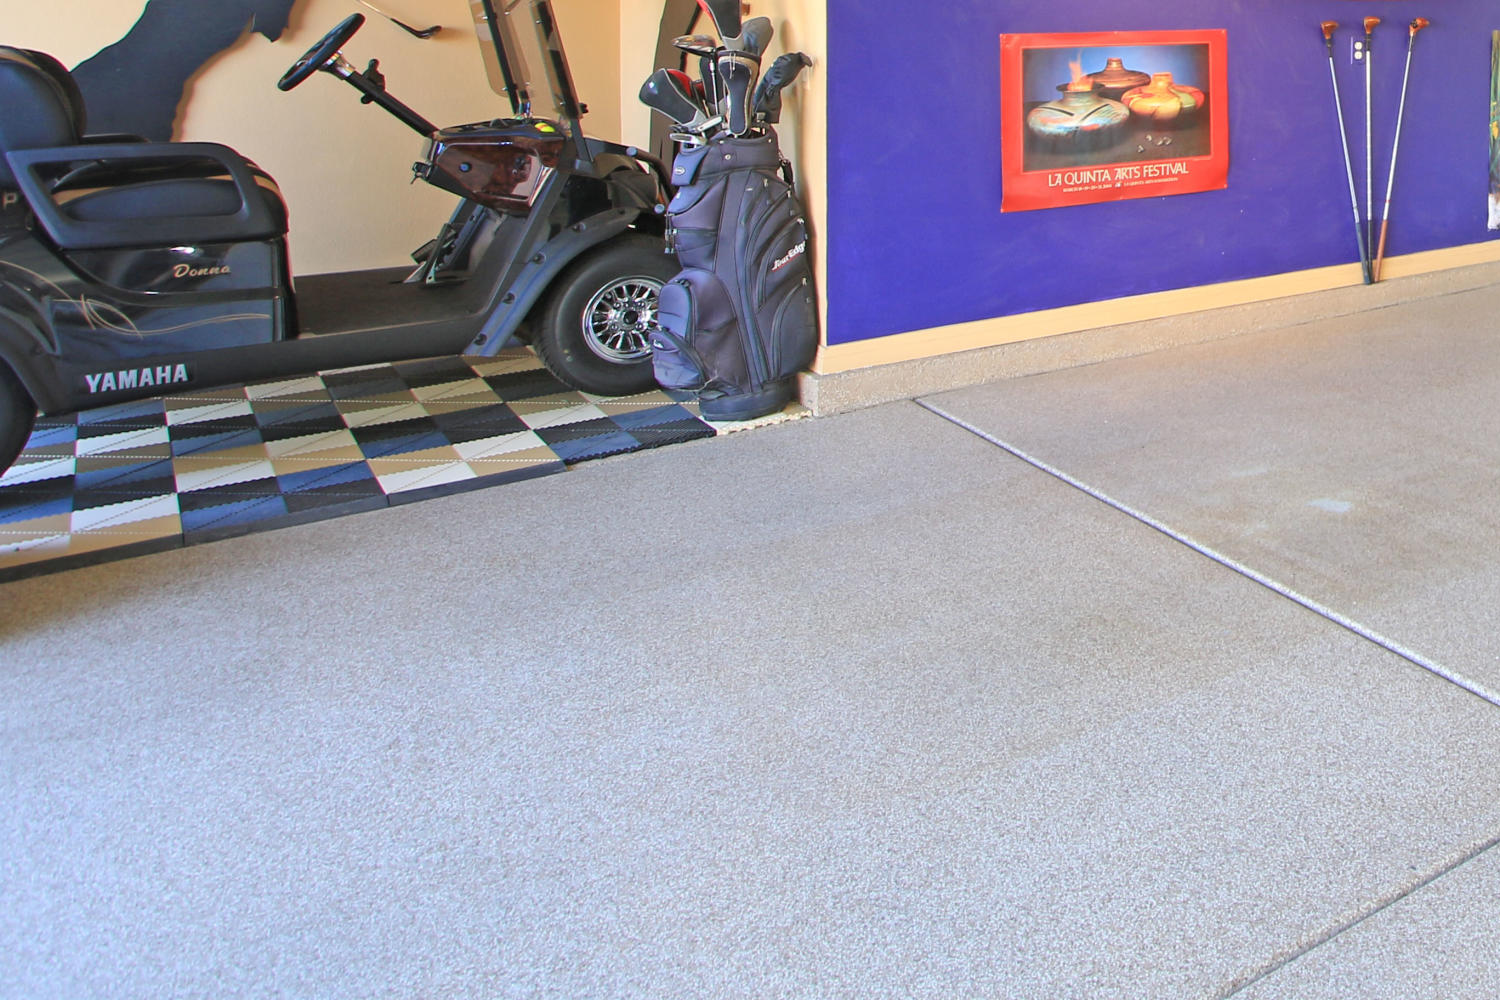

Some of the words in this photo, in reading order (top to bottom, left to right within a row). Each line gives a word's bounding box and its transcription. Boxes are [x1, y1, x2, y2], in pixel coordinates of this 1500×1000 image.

[1048, 173, 1062, 187] LA
[1064, 169, 1112, 185] QUINTA
[1114, 166, 1141, 181] ARTS
[1143, 161, 1189, 178] FESTIVAL
[173, 263, 231, 279] Donna
[85, 363, 189, 393] YAMAHA
